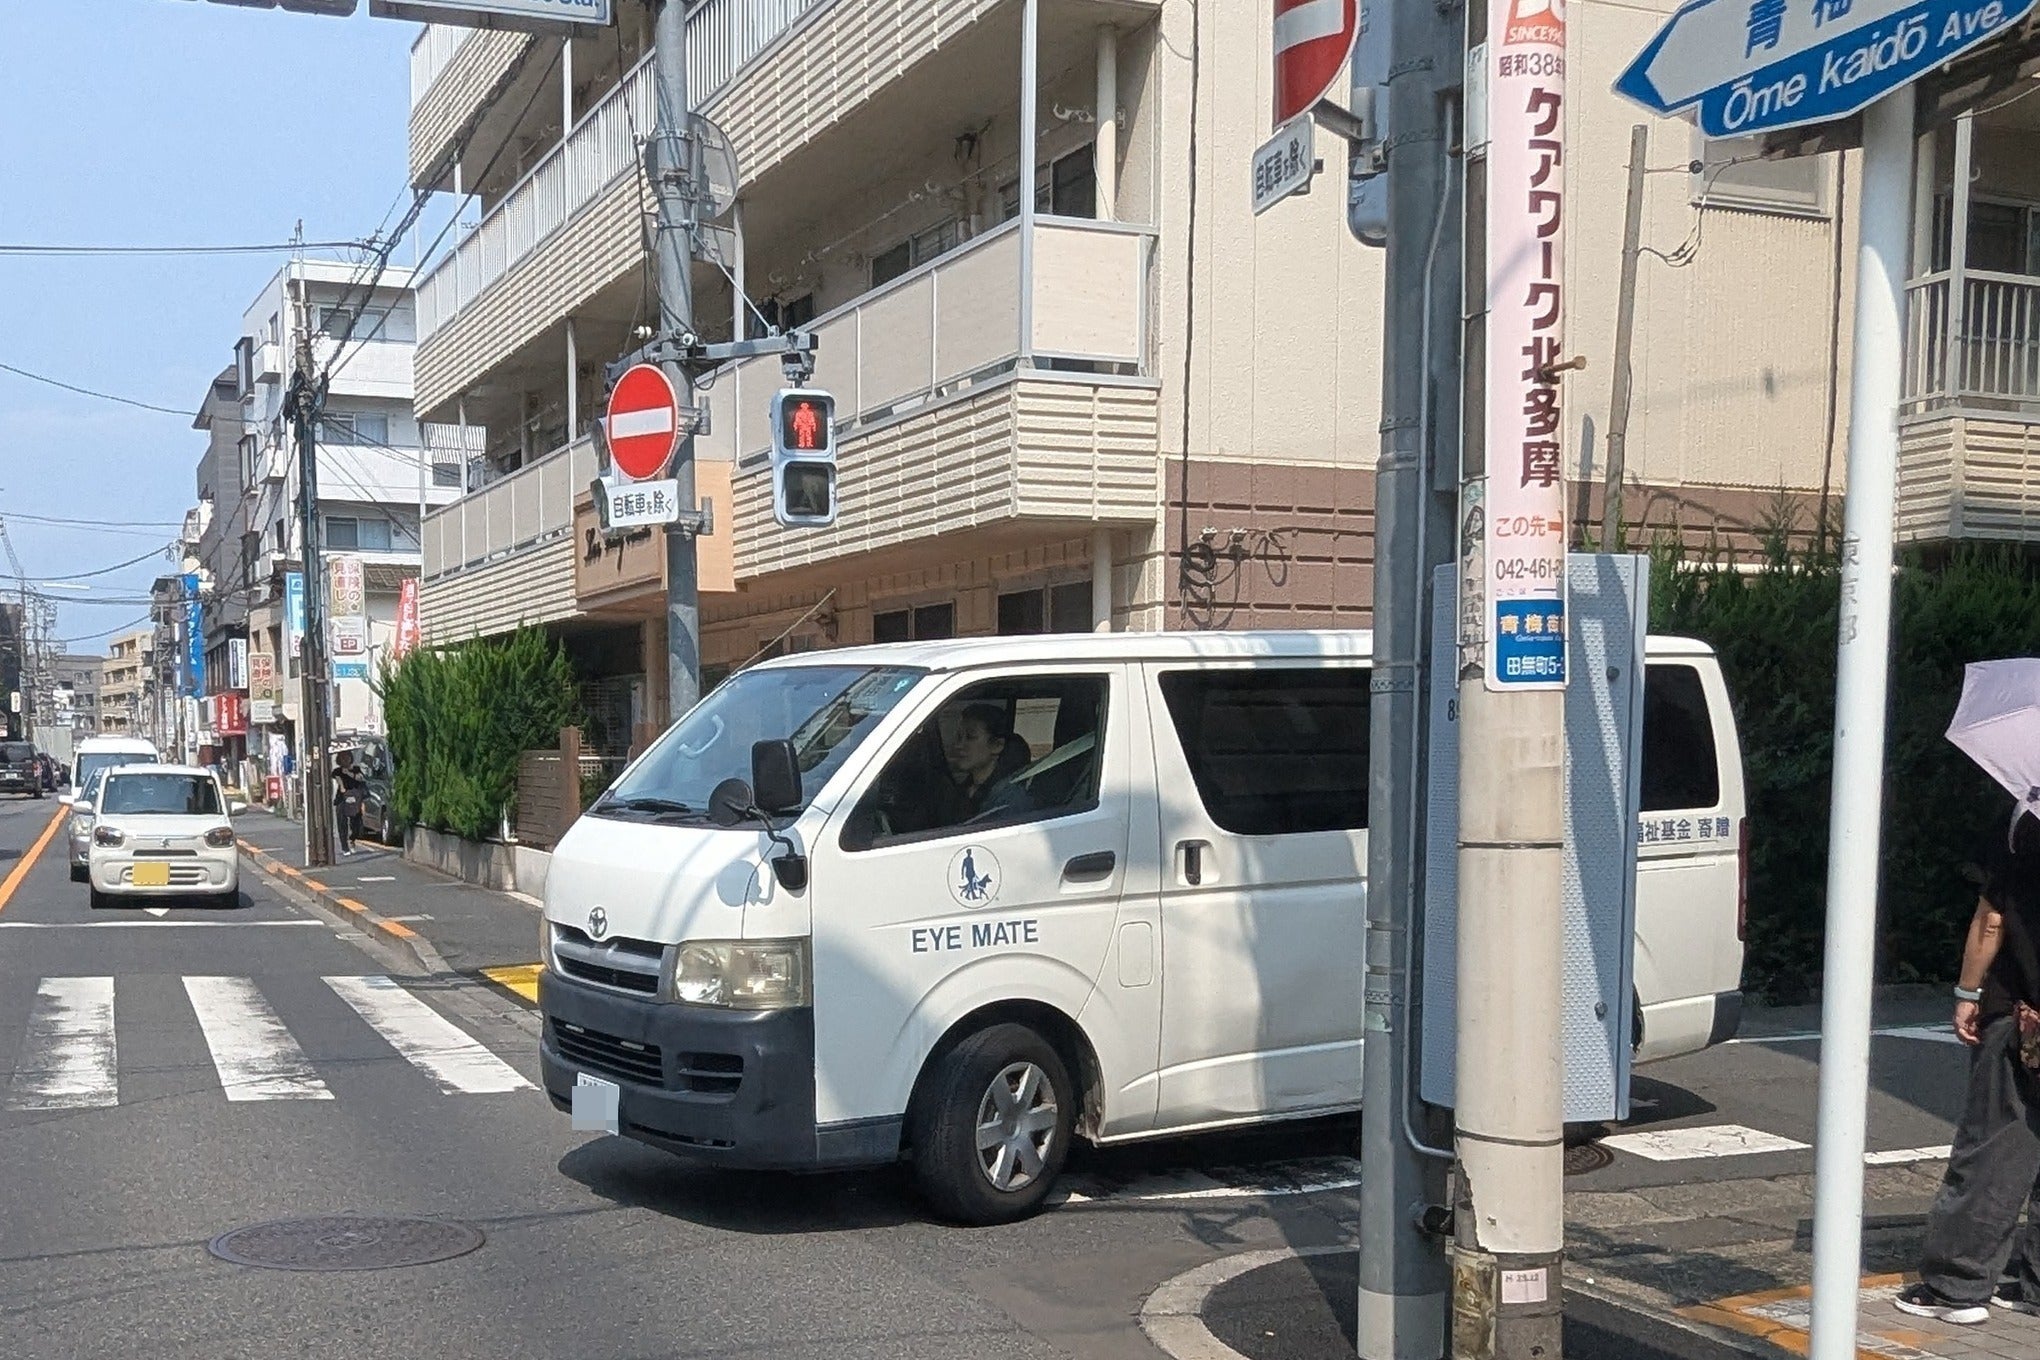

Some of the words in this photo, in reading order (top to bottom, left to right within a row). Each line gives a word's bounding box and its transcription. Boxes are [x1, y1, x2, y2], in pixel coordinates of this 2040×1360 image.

[1520, 87, 1562, 490] ケアワーク北多摩
[613, 489, 672, 519] 自転車を除く
[1496, 515, 1546, 538] この先
[912, 926, 962, 953] EYE
[972, 919, 1019, 948] MATE
